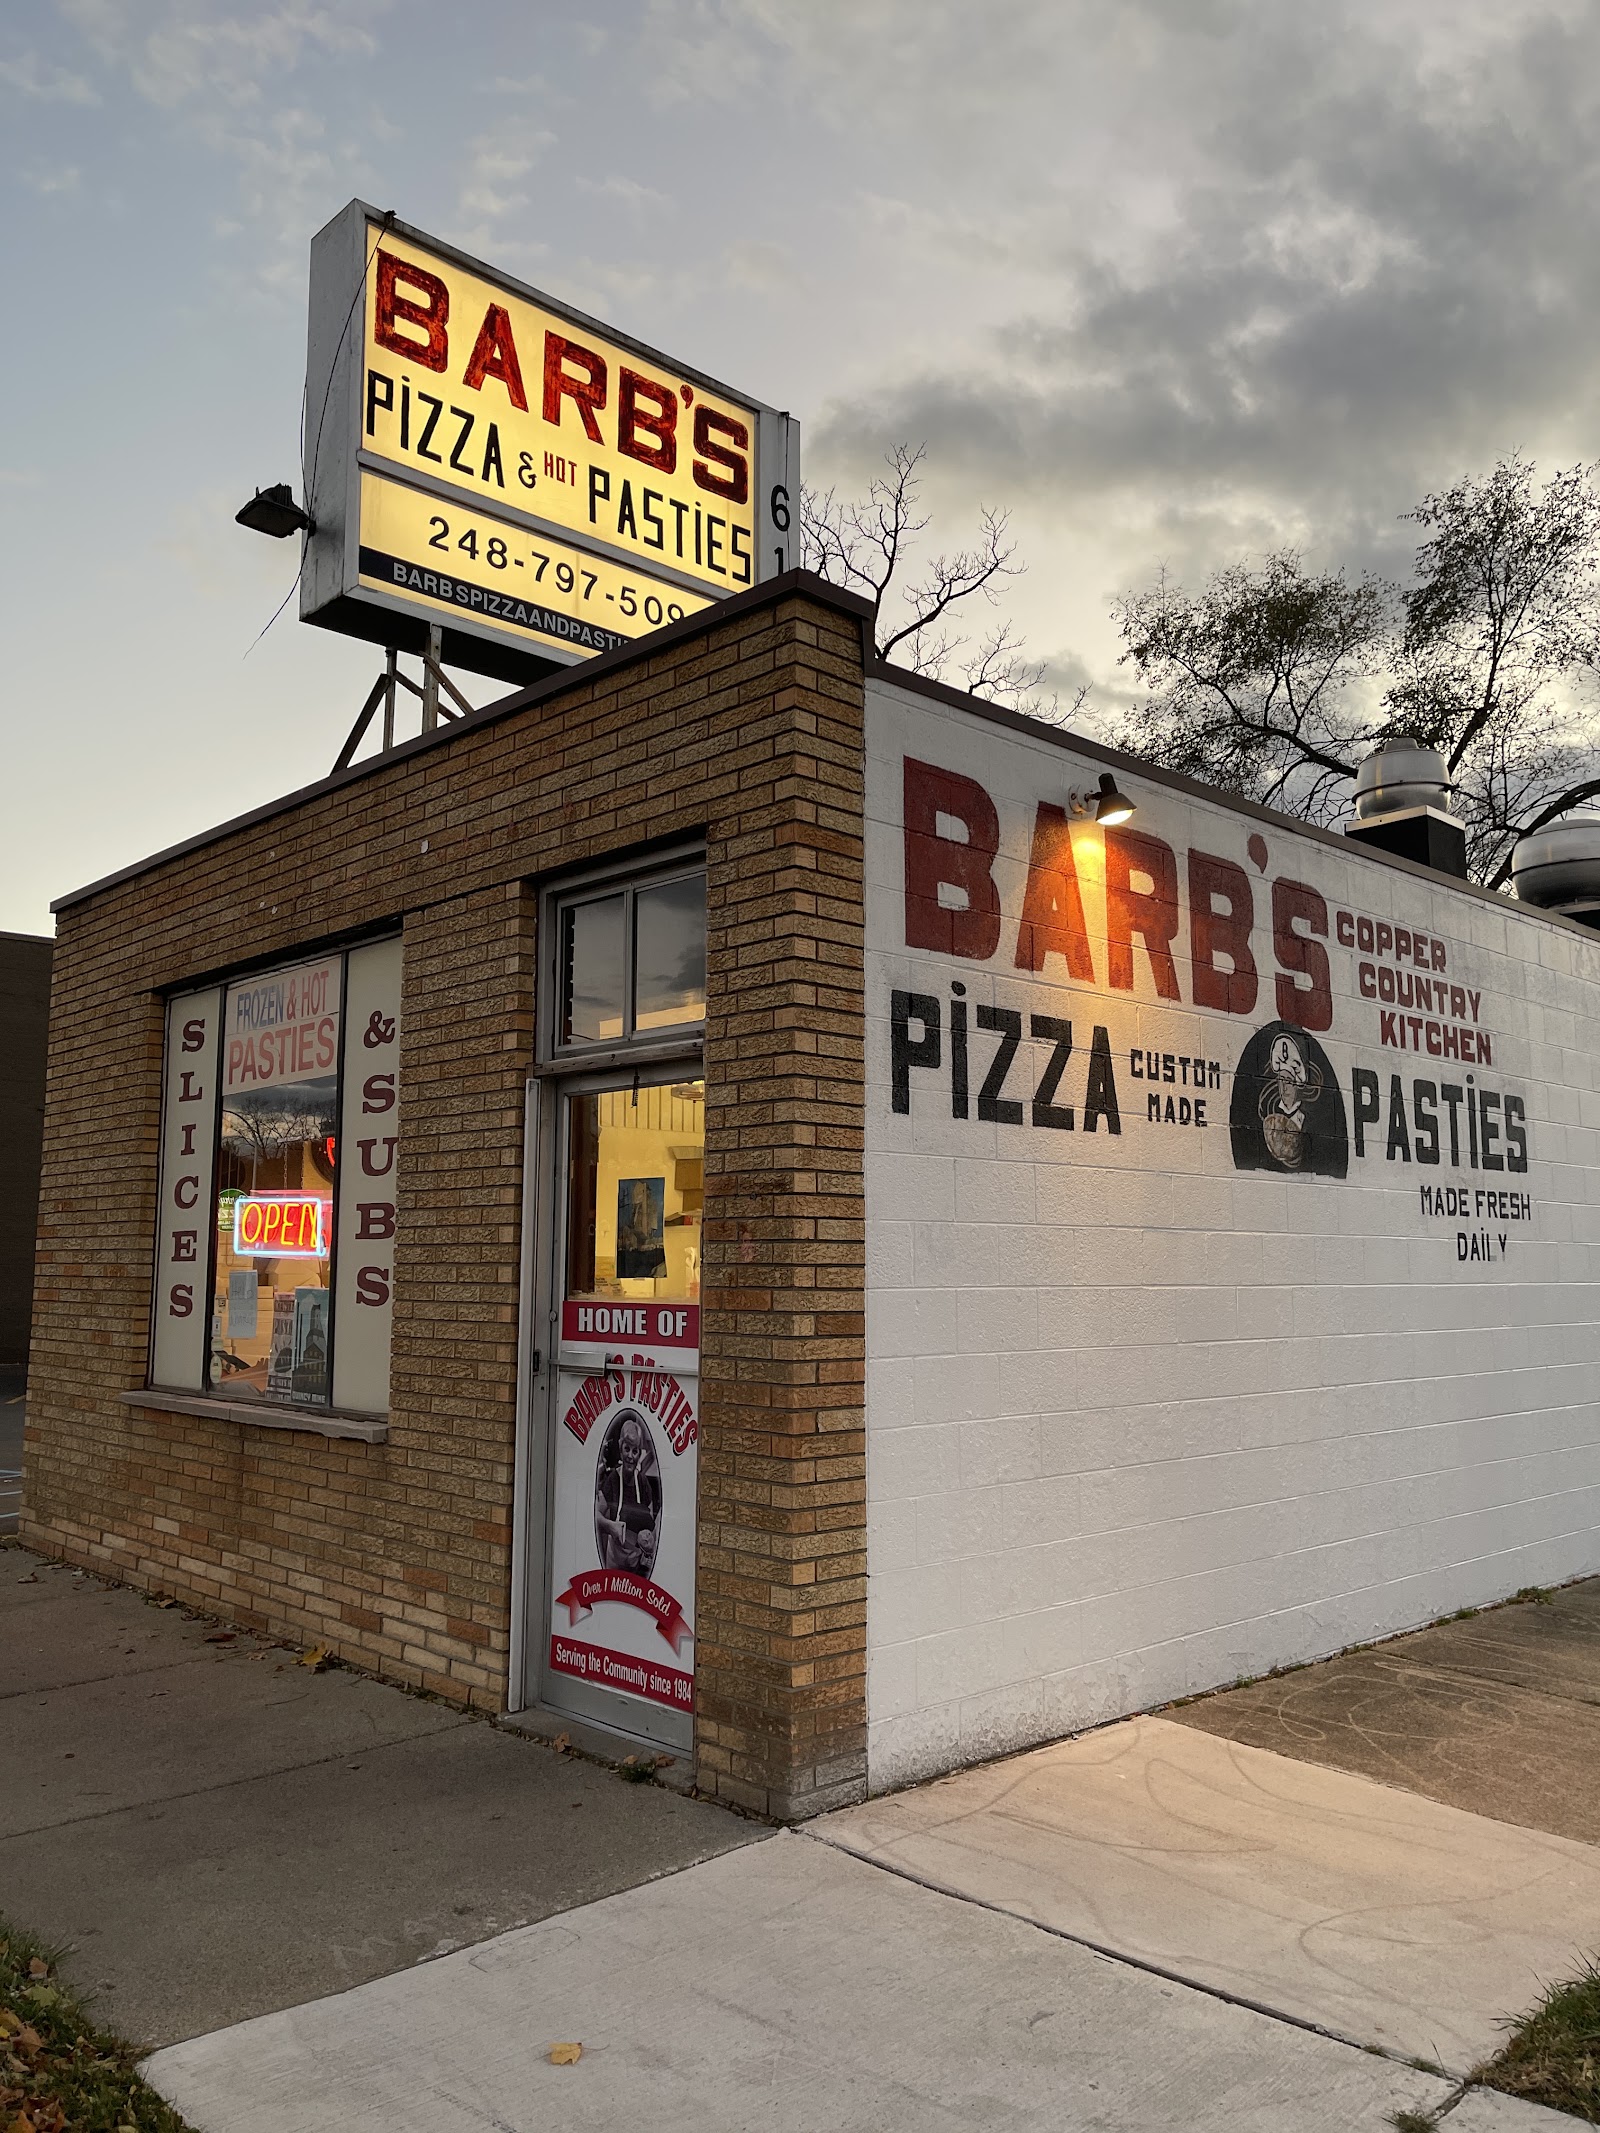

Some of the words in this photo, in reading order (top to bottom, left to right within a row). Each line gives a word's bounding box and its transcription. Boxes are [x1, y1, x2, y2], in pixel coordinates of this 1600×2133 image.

[374, 247, 749, 505] BARB'S
[518, 451, 537, 489] &
[543, 451, 577, 487] HOT
[392, 562, 629, 652] BARBSPIZZAANDPASTI
[903, 754, 1333, 1032] BARB'S
[1336, 910, 1447, 973] COPPER
[236, 982, 285, 1033] FROZEN
[286, 978, 297, 1021] &
[300, 969, 329, 1018] HOT
[1358, 961, 1482, 1023] COUNTRY
[228, 1017, 335, 1085] PASTIES
[1380, 1009, 1493, 1066] KITCHEN
[1130, 1048, 1221, 1090] CUSTOM
[1147, 1092, 1208, 1128] MADE
[242, 1202, 318, 1248] OPEN
[1420, 1185, 1470, 1217] MADE
[1475, 1189, 1531, 1221] FRESH
[577, 1307, 648, 1336] HOME
[657, 1310, 688, 1338] OF
[582, 1581, 603, 1598] Over
[610, 1576, 644, 1600] Million
[646, 1588, 672, 1617] Sold
[556, 1643, 586, 1674] Serving
[588, 1651, 601, 1673] the
[603, 1655, 648, 1693] Community
[650, 1671, 672, 1696] since
[673, 1677, 692, 1703] 1984
